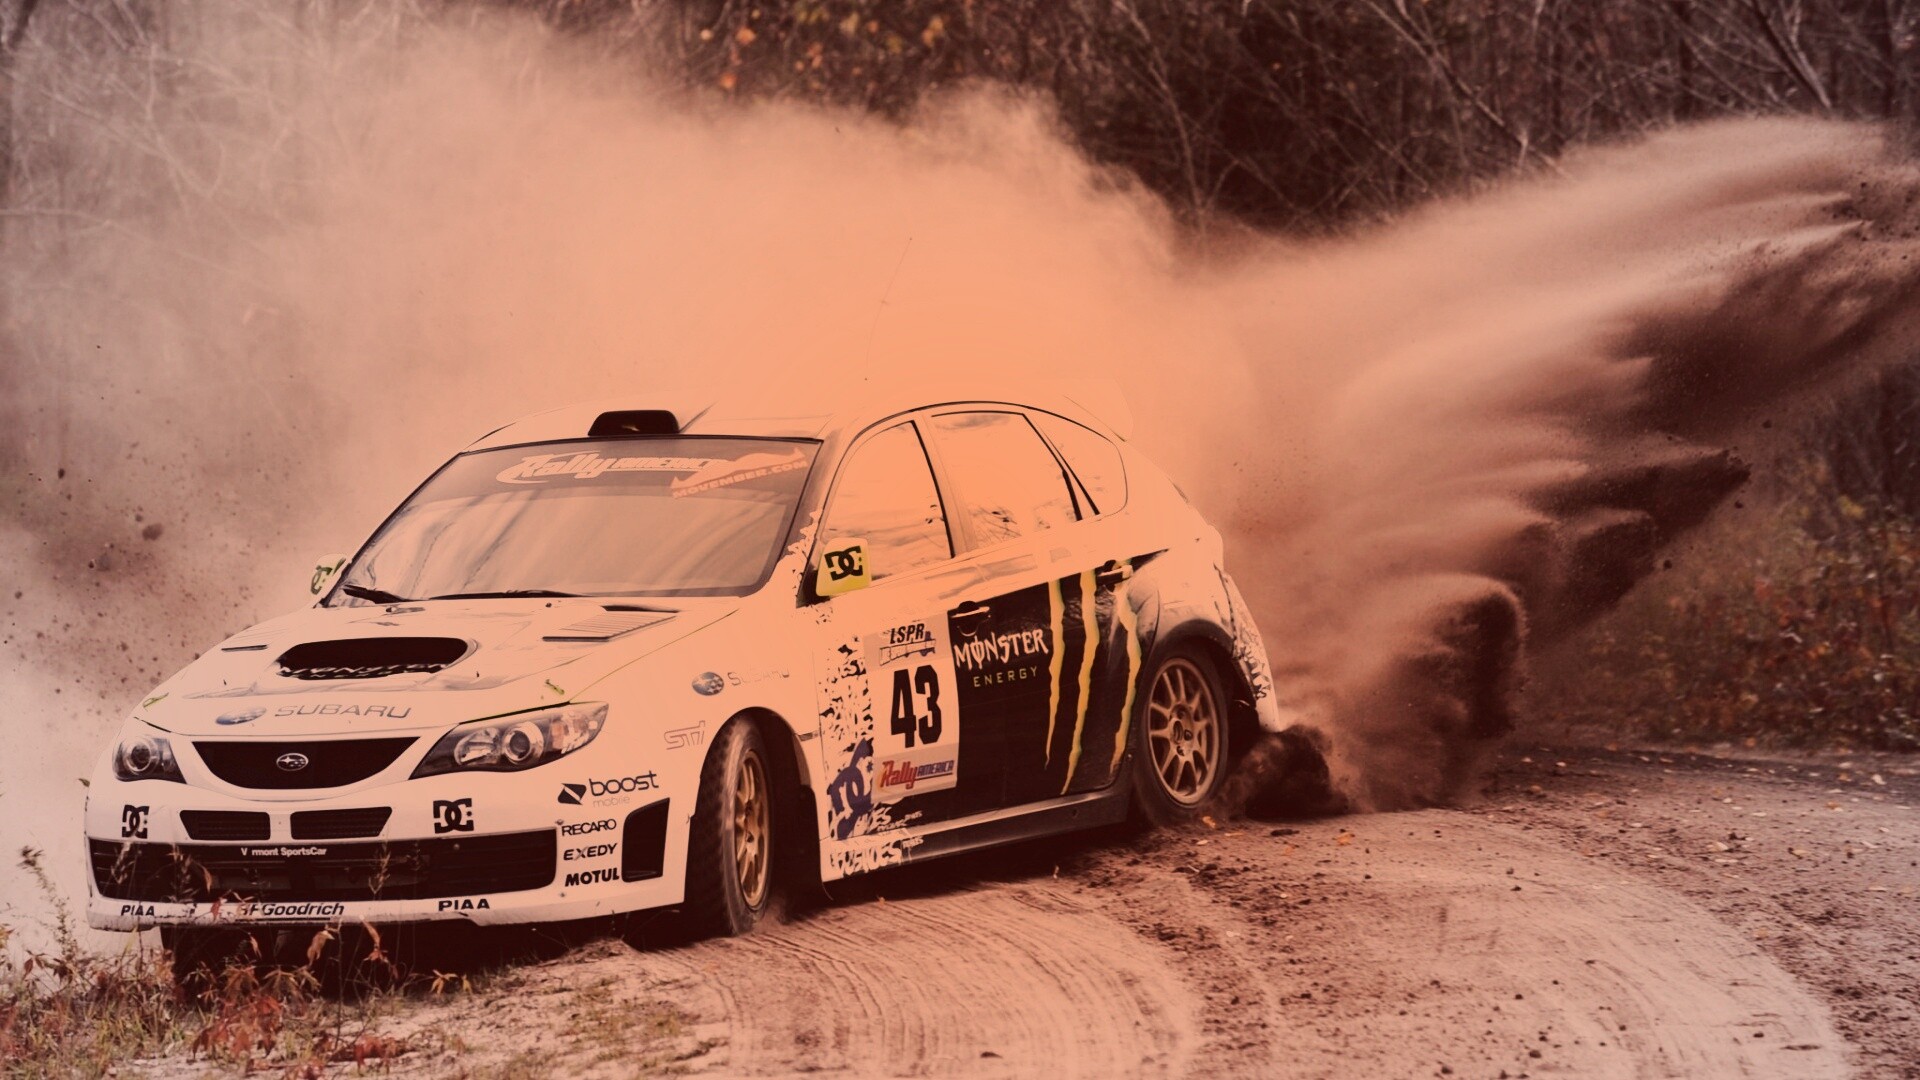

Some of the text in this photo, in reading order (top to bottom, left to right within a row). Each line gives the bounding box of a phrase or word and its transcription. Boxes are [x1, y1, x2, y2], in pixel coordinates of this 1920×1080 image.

[889, 623, 925, 645] LSPR
[953, 629, 1049, 671] MONSTER
[973, 666, 1037, 688] ENERGY
[274, 704, 412, 719] SUBARU
[890, 664, 942, 749] 43
[588, 770, 659, 797] boost
[879, 760, 919, 790] Rally
[122, 804, 149, 839] DC
[433, 798, 474, 834] DC
[561, 818, 617, 837] RECARO
[241, 846, 327, 858] Vrmont SportsCar
[563, 843, 618, 861] EXEDY
[564, 867, 620, 887] MOTUL
[121, 905, 155, 917] PIAA
[439, 898, 490, 912] PIAA
